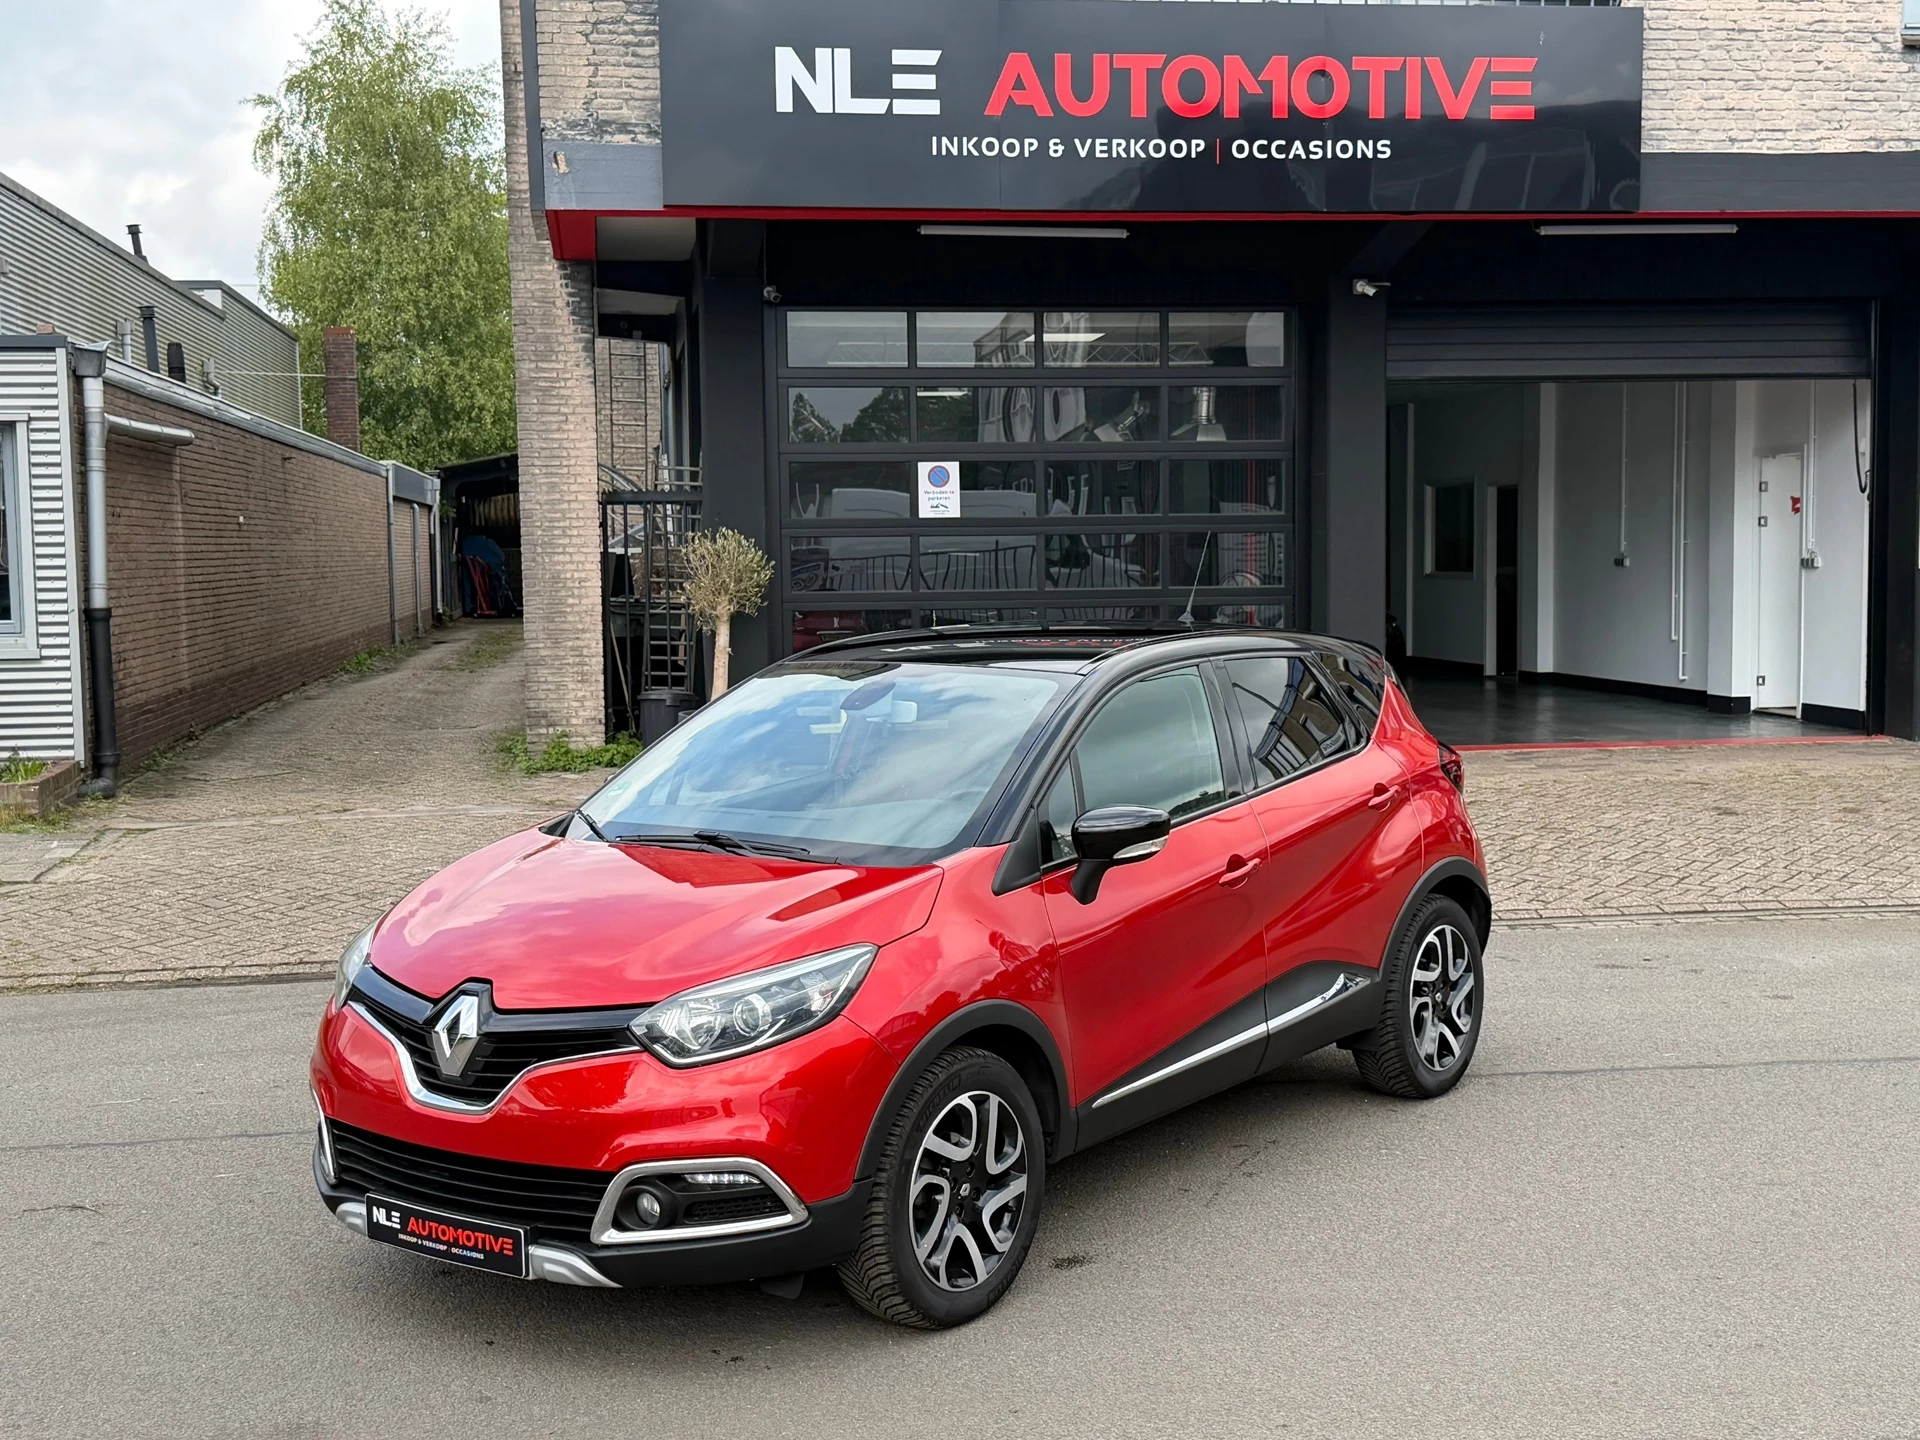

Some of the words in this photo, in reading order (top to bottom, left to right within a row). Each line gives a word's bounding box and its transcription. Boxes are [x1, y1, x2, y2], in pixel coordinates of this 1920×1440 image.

[774, 45, 943, 116] NLE
[985, 53, 1539, 120] AUTOMOTIVE
[931, 135, 1039, 158] INKOOP
[1048, 138, 1065, 158] &
[1073, 137, 1206, 159] VERKOOP
[1231, 139, 1392, 160] OCCASIONS
[372, 1205, 401, 1229] NLE
[407, 1216, 514, 1256] AUTOMOTIVE
[398, 1233, 418, 1243] INKOOP
[422, 1240, 448, 1251] VERKOOP
[451, 1247, 484, 1260] OCCASIONS
